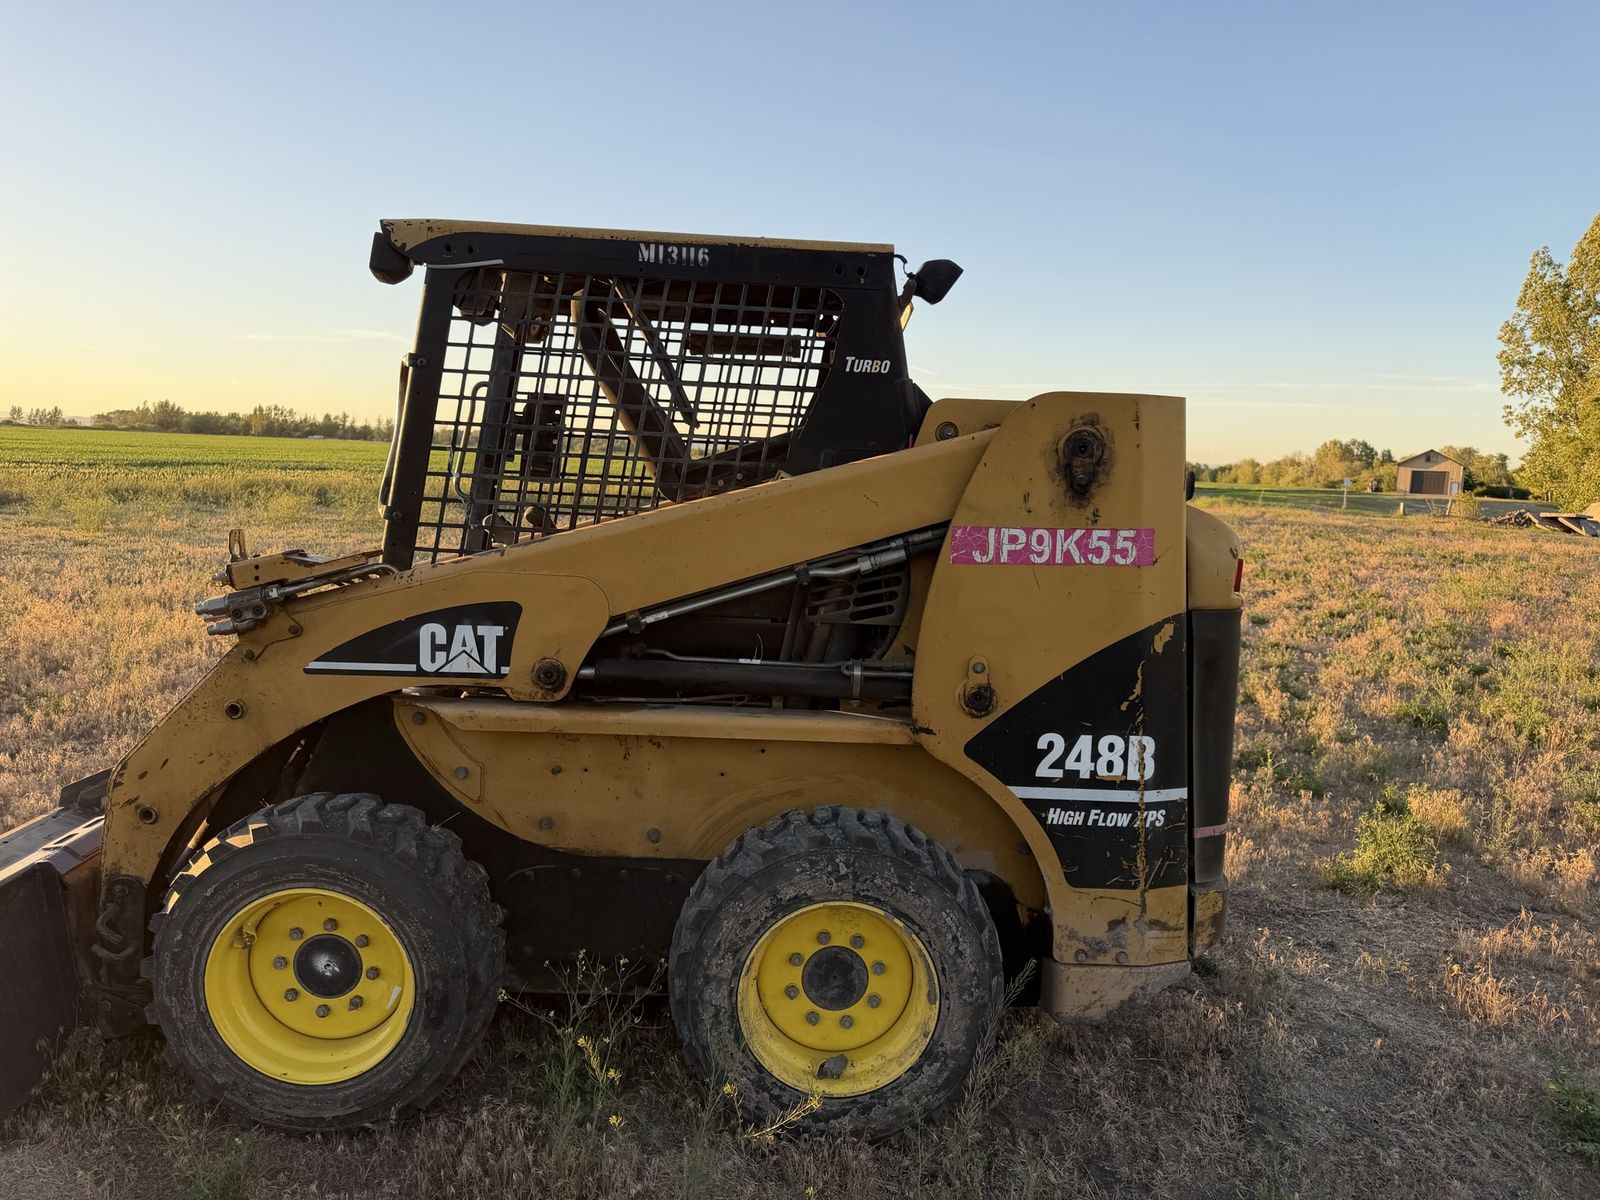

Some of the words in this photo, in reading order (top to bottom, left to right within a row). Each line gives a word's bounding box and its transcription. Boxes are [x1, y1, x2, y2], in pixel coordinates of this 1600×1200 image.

[845, 356, 891, 374] TURBO
[972, 528, 1137, 565] JP9K55
[419, 622, 504, 674] CAT
[1034, 732, 1156, 781] 248B
[1046, 808, 1086, 826] HIGH
[1087, 809, 1133, 828] FLOW
